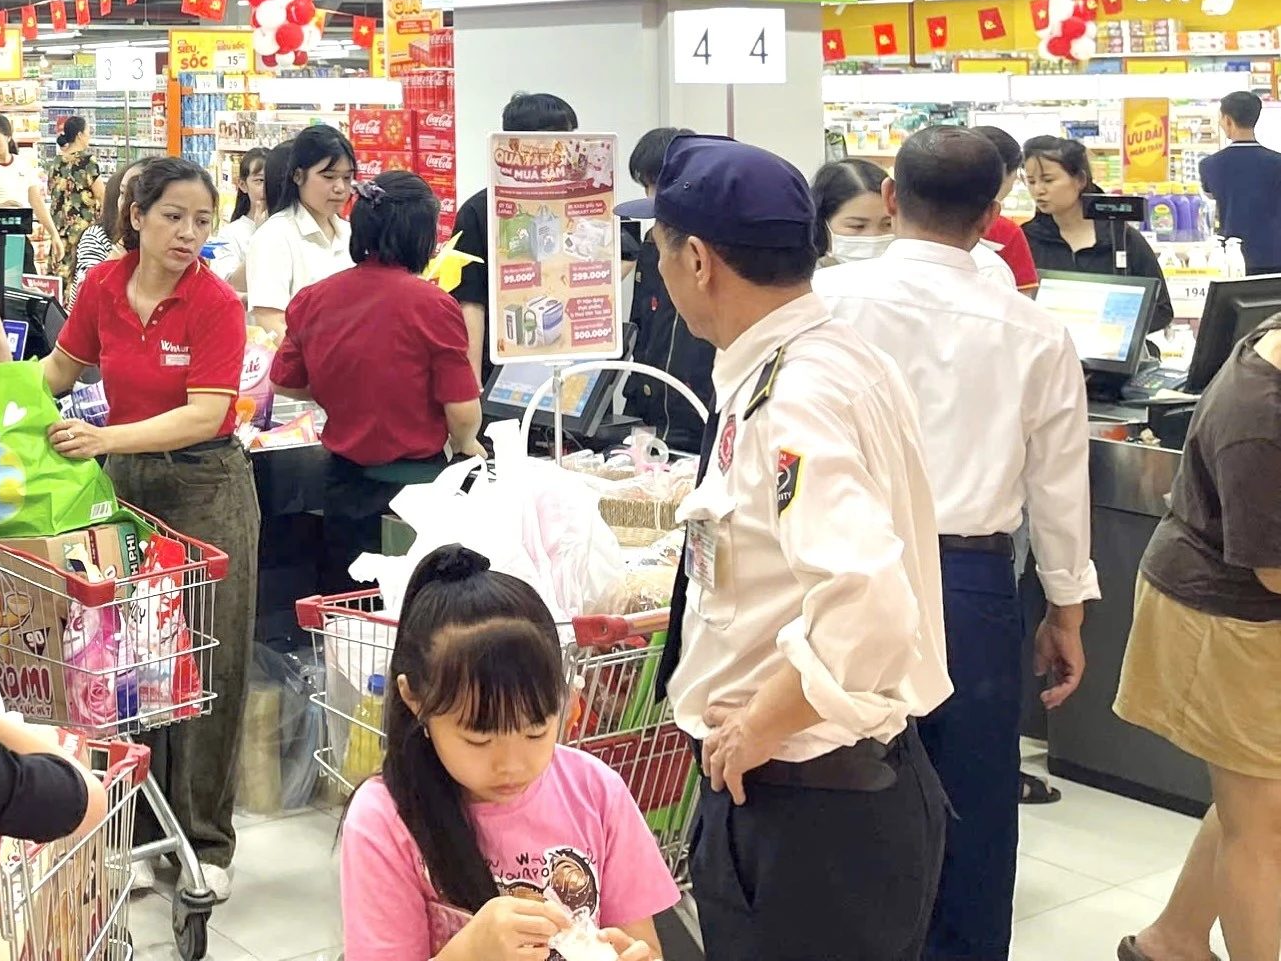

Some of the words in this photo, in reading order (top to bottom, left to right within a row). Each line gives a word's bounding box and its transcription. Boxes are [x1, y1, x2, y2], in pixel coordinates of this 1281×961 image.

[693, 27, 712, 65] 4
[749, 27, 768, 64] 4
[104, 58, 113, 81] 3
[131, 58, 144, 80] 3
[180, 51, 208, 70] SỐC
[227, 55, 239, 66] 15
[514, 168, 539, 180] MUA
